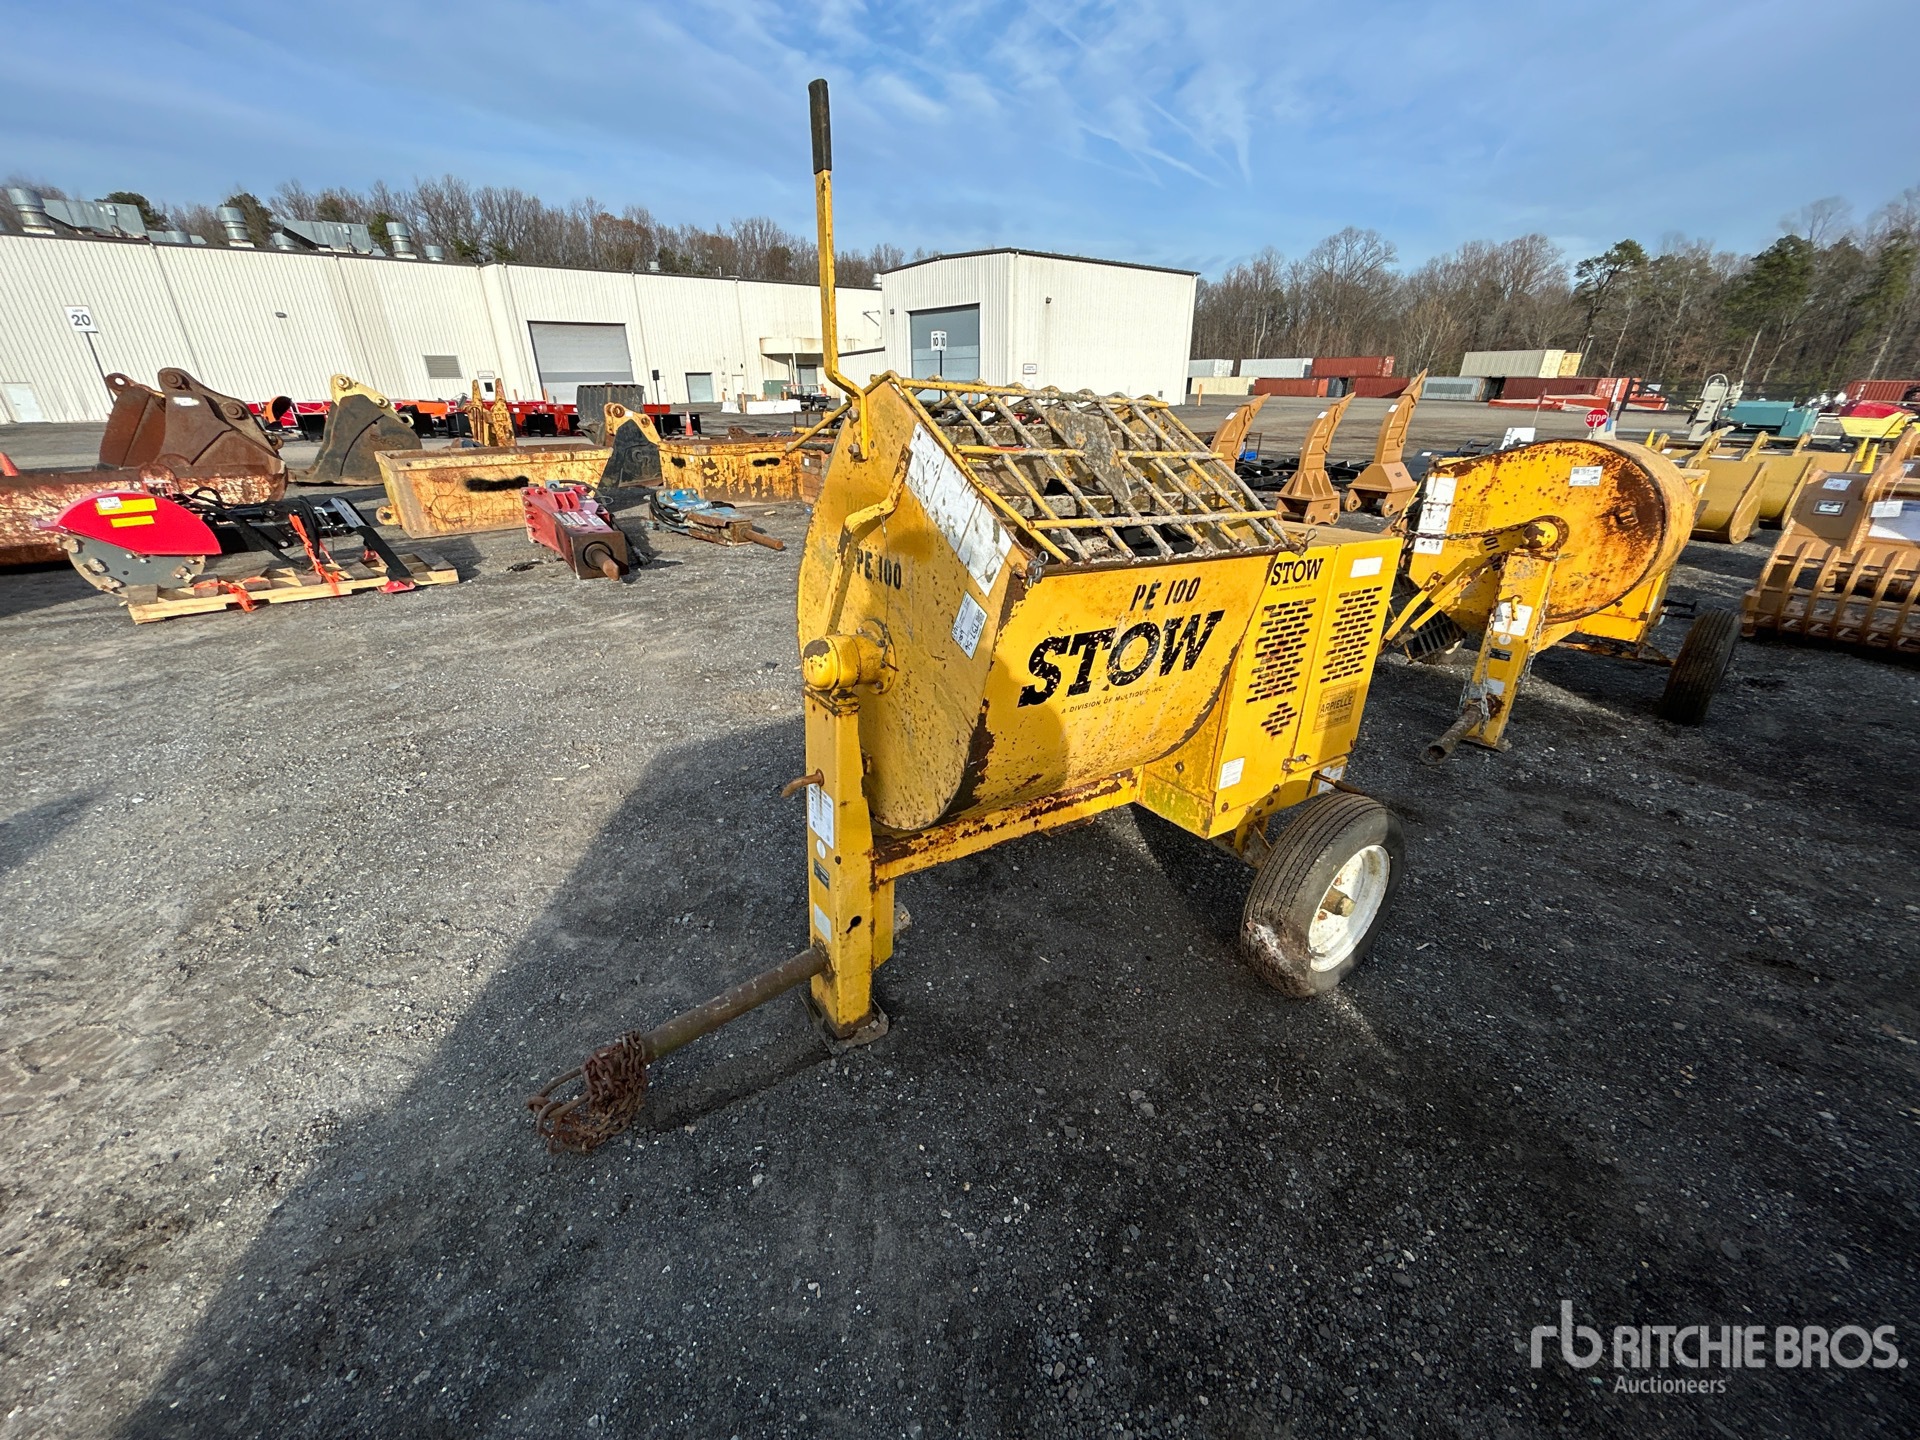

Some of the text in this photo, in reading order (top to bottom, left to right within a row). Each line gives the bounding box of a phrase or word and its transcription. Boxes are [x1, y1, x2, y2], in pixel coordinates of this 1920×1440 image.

[71, 314, 91, 326] 20
[1587, 414, 1607, 422] STOP
[1460, 505, 1474, 545] APIELLE
[857, 548, 902, 590] PE 100
[1270, 558, 1324, 586] STOW
[1129, 577, 1201, 612] PE 100
[1017, 610, 1225, 708] STOW
[1069, 701, 1101, 713] DIVISION
[1320, 696, 1353, 713] ARPIELLE
